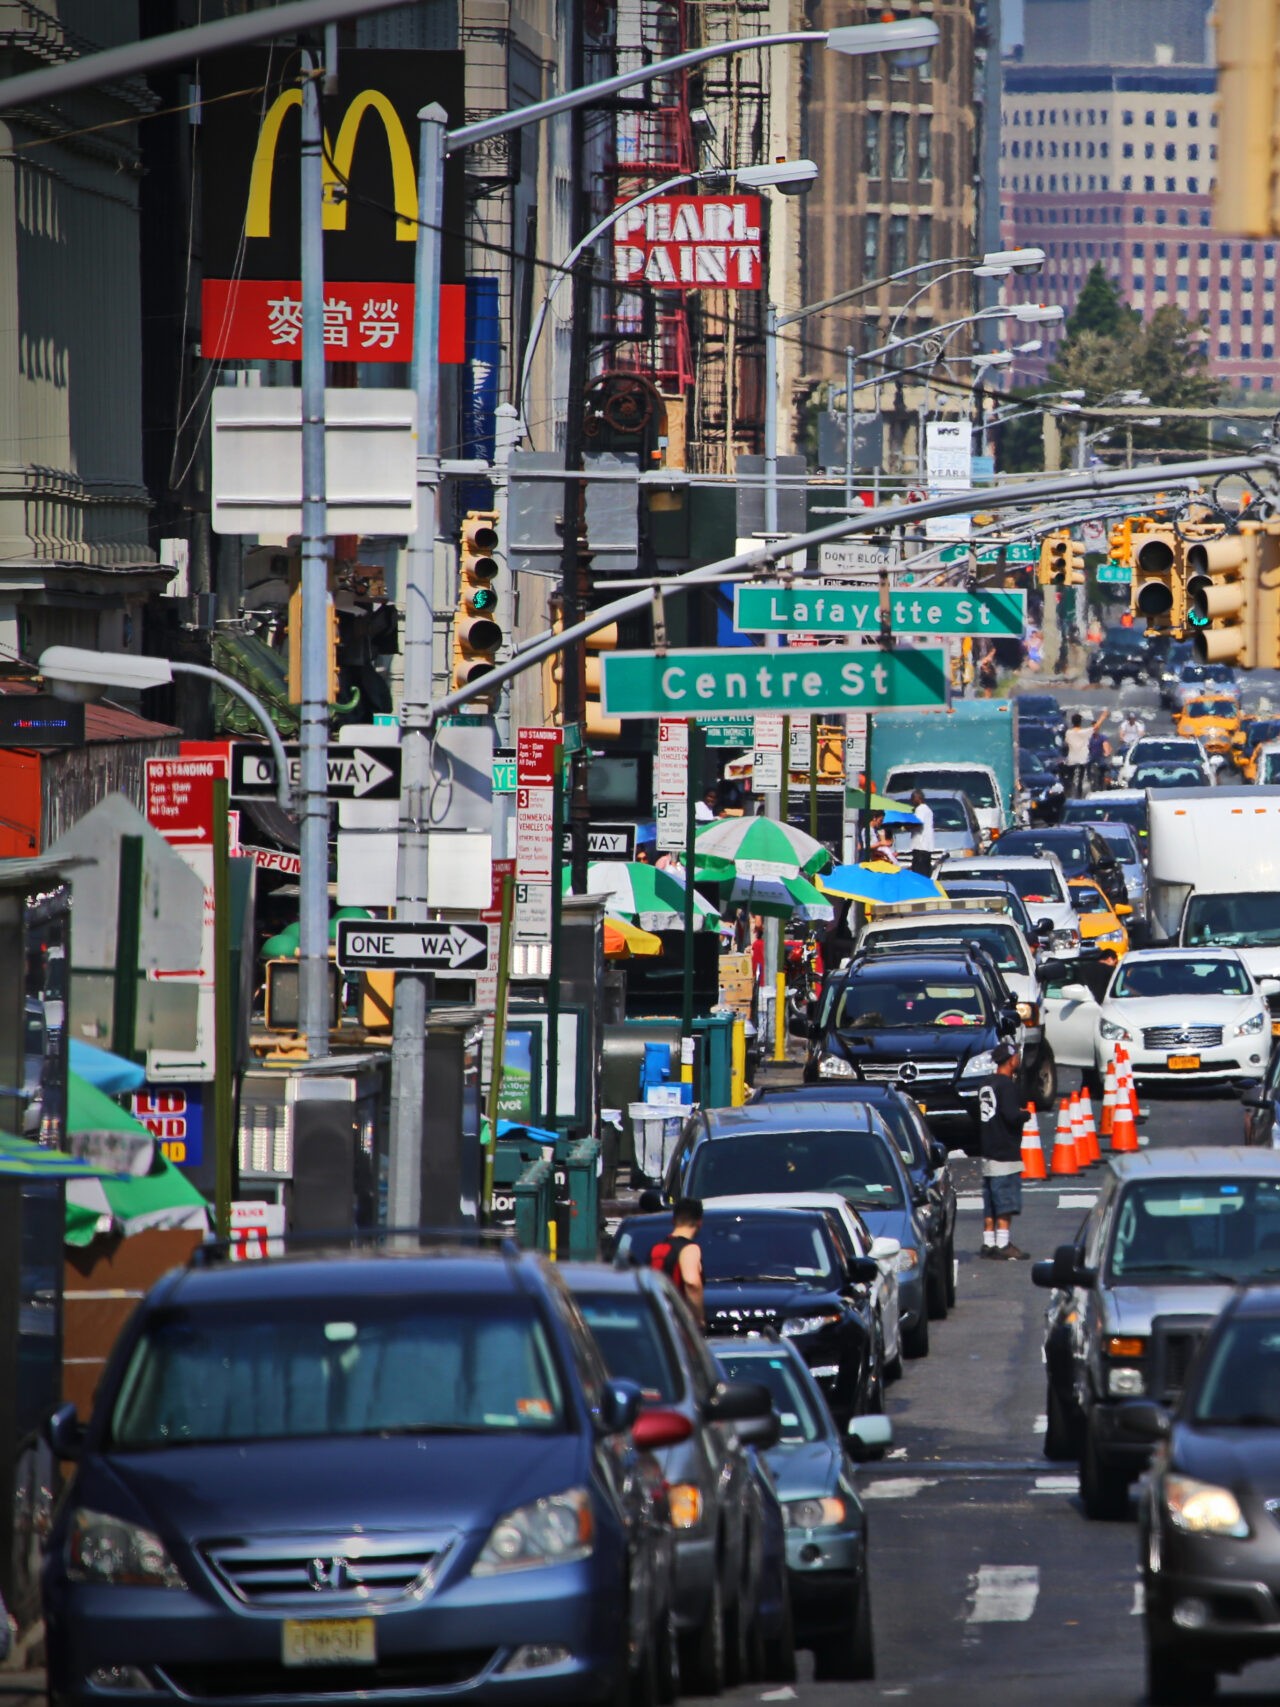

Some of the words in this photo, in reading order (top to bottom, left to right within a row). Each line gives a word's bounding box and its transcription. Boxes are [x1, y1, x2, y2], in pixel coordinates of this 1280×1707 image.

[614, 203, 760, 241] PEARL
[614, 245, 760, 283] PAINT
[267, 297, 399, 348] 麥當勞
[937, 427, 960, 436] NYC
[955, 600, 991, 625] St
[661, 664, 824, 700] Centre
[840, 662, 889, 696] St
[660, 727, 668, 740] 3
[754, 752, 763, 766] 5
[149, 763, 165, 777] NO
[166, 762, 214, 777] STANDING
[256, 759, 300, 781] OE
[327, 762, 376, 783] WAY
[519, 789, 528, 808] 3
[519, 813, 552, 821] COMMERCIA
[658, 802, 667, 817] 5
[587, 836, 620, 851] WAY
[492, 862, 512, 872] TANDING
[518, 885, 526, 902] 5
[351, 935, 395, 954] ONE
[421, 937, 468, 956] WAY
